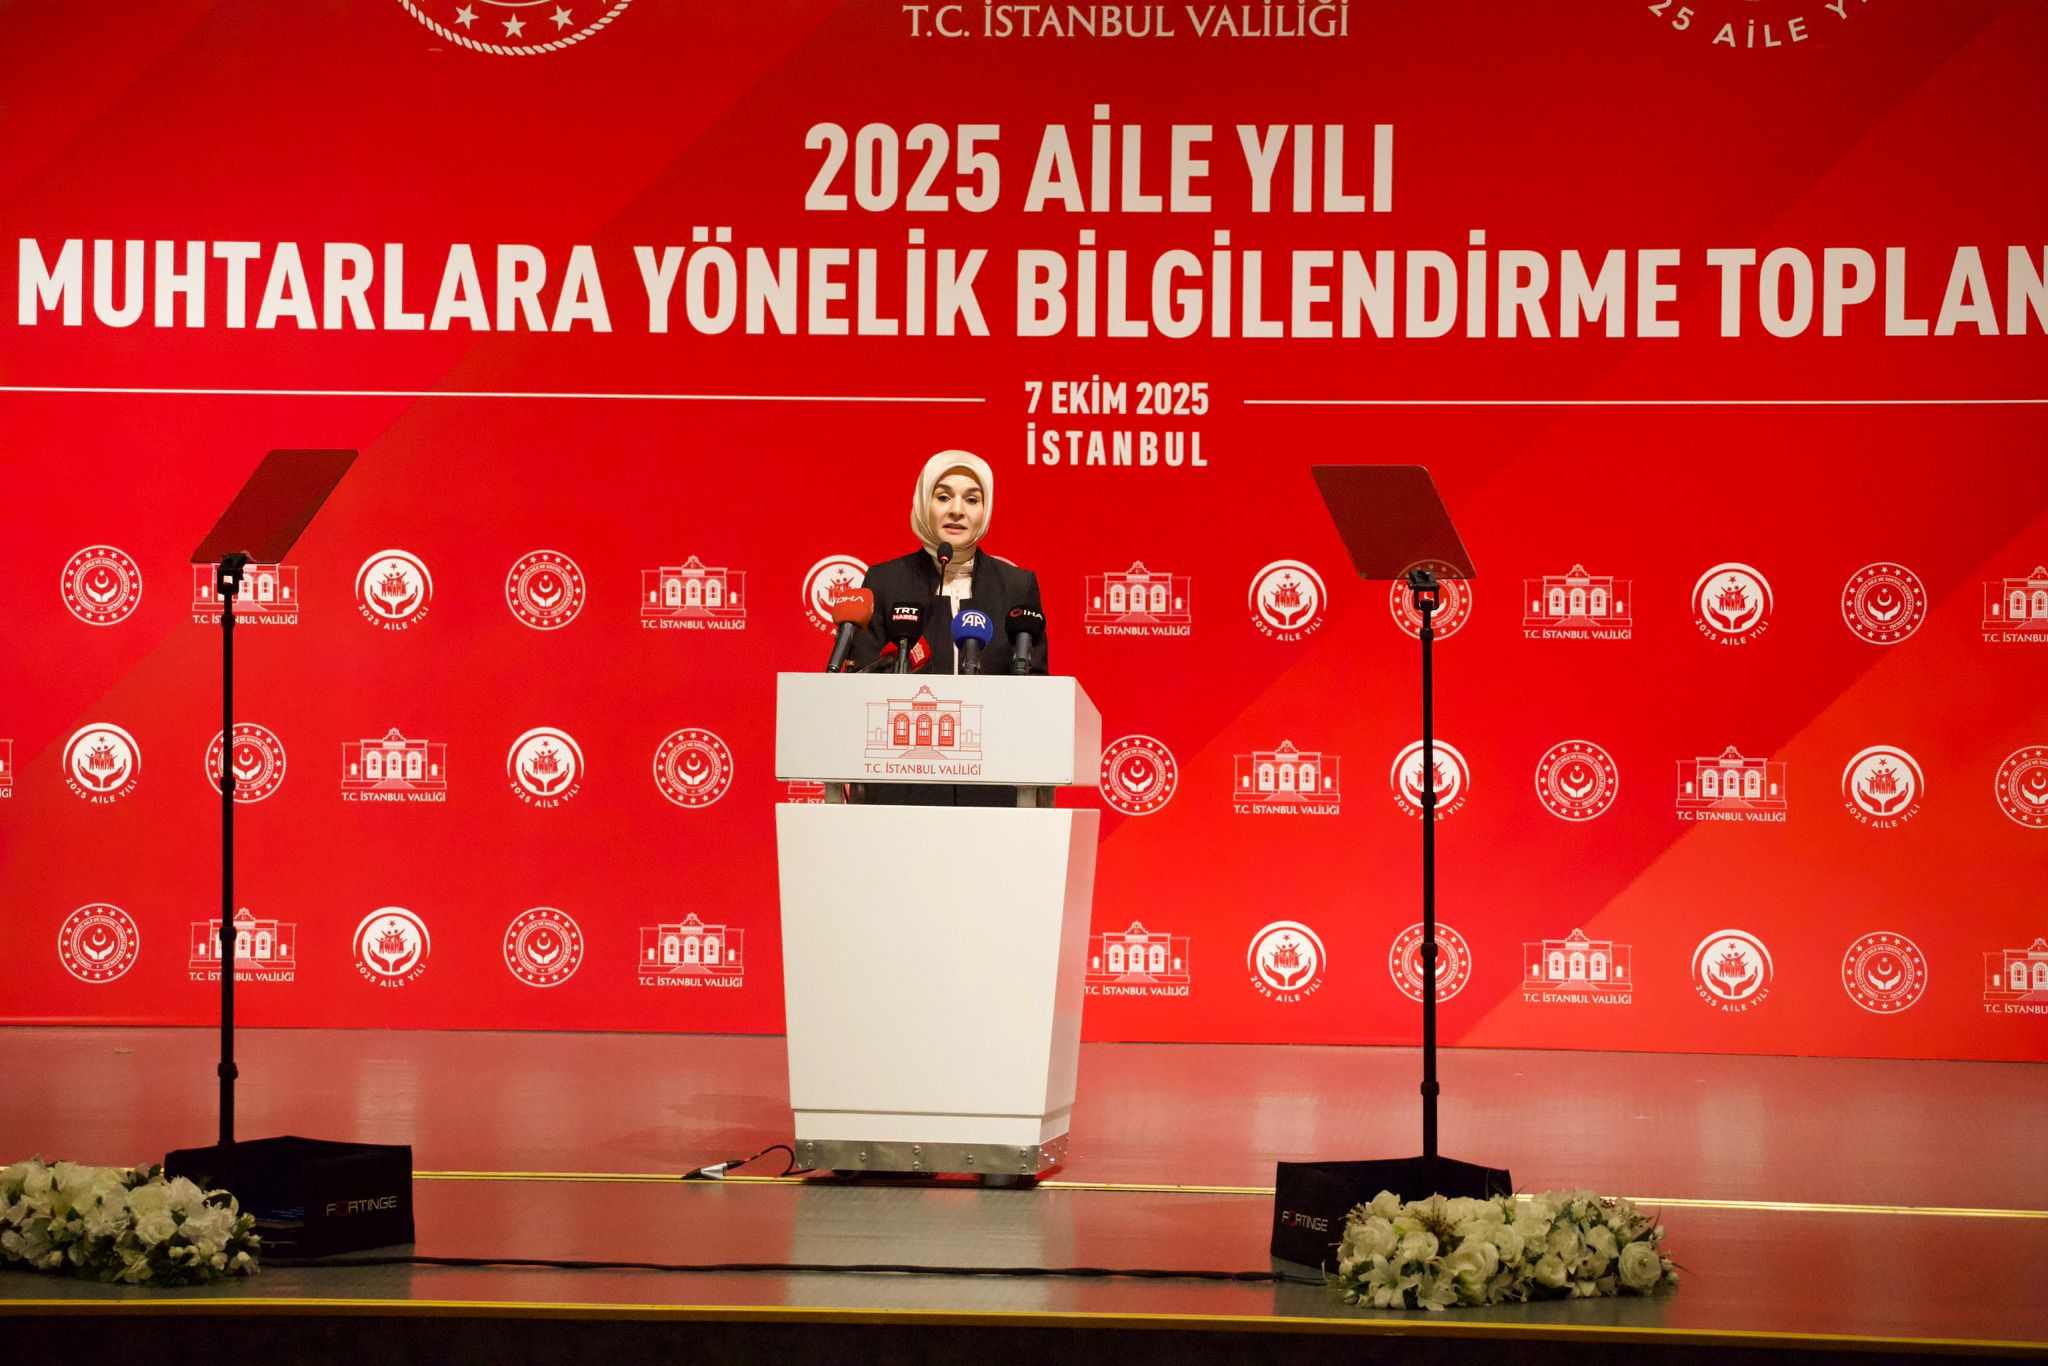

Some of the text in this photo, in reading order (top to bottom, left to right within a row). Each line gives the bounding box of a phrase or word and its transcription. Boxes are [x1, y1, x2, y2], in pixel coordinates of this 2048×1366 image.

[903, 0, 1348, 36] T.C. İSTANBUL VALİLİĞİ
[1712, 17, 1808, 48] AİLE
[805, 104, 1394, 213] 2025 AİLE YILI
[19, 238, 612, 333] MUHTARLARA
[634, 227, 990, 336] YÖNELİK
[1017, 230, 1680, 338] BİLGİLENDİRME
[1025, 374, 1209, 415] 7 EKİM 2025
[1027, 422, 1208, 467] İSTANBUL
[212, 614, 257, 625] İSNBUL
[358, 604, 380, 626] 2025
[411, 606, 429, 624] YILI
[805, 609, 827, 631] 2025
[894, 607, 918, 615] TRT
[962, 612, 986, 629] AA
[660, 619, 705, 629] İSTANBUL
[1104, 624, 1150, 635] İSTANBUL
[1252, 614, 1274, 637] 2025
[1305, 617, 1323, 635] YILI
[1543, 628, 1589, 640] İSTANBUL
[1695, 618, 1718, 641] 2025
[1750, 620, 1768, 638] YILI
[2003, 632, 2048, 643] İSTANBU
[886, 762, 936, 775] İSTANBUL
[66, 777, 88, 799] 2025
[119, 779, 137, 797] YILI
[361, 791, 405, 802] İSTANBUL
[510, 781, 532, 803] 2025
[563, 783, 581, 801] YILI
[1253, 804, 1298, 815] İSTANBUL
[1394, 794, 1416, 817] 2025
[1447, 796, 1466, 815] YILI
[1696, 810, 1743, 822] İSTANBUL
[1845, 800, 1868, 824] 2025
[1901, 802, 1920, 822] YILI
[208, 971, 253, 981] İSTBUL
[356, 961, 377, 983] 2025
[408, 962, 426, 981] YILI
[657, 976, 702, 987] İSTANBUL
[1103, 984, 1148, 996] İSTANBUL
[1251, 975, 1273, 998] 2025
[1304, 977, 1322, 996] YILI
[1695, 984, 1718, 1007] 2025
[1751, 987, 1769, 1006] YILI
[1543, 992, 1589, 1004] İSTANBUL
[326, 1196, 398, 1217] FORTINGE
